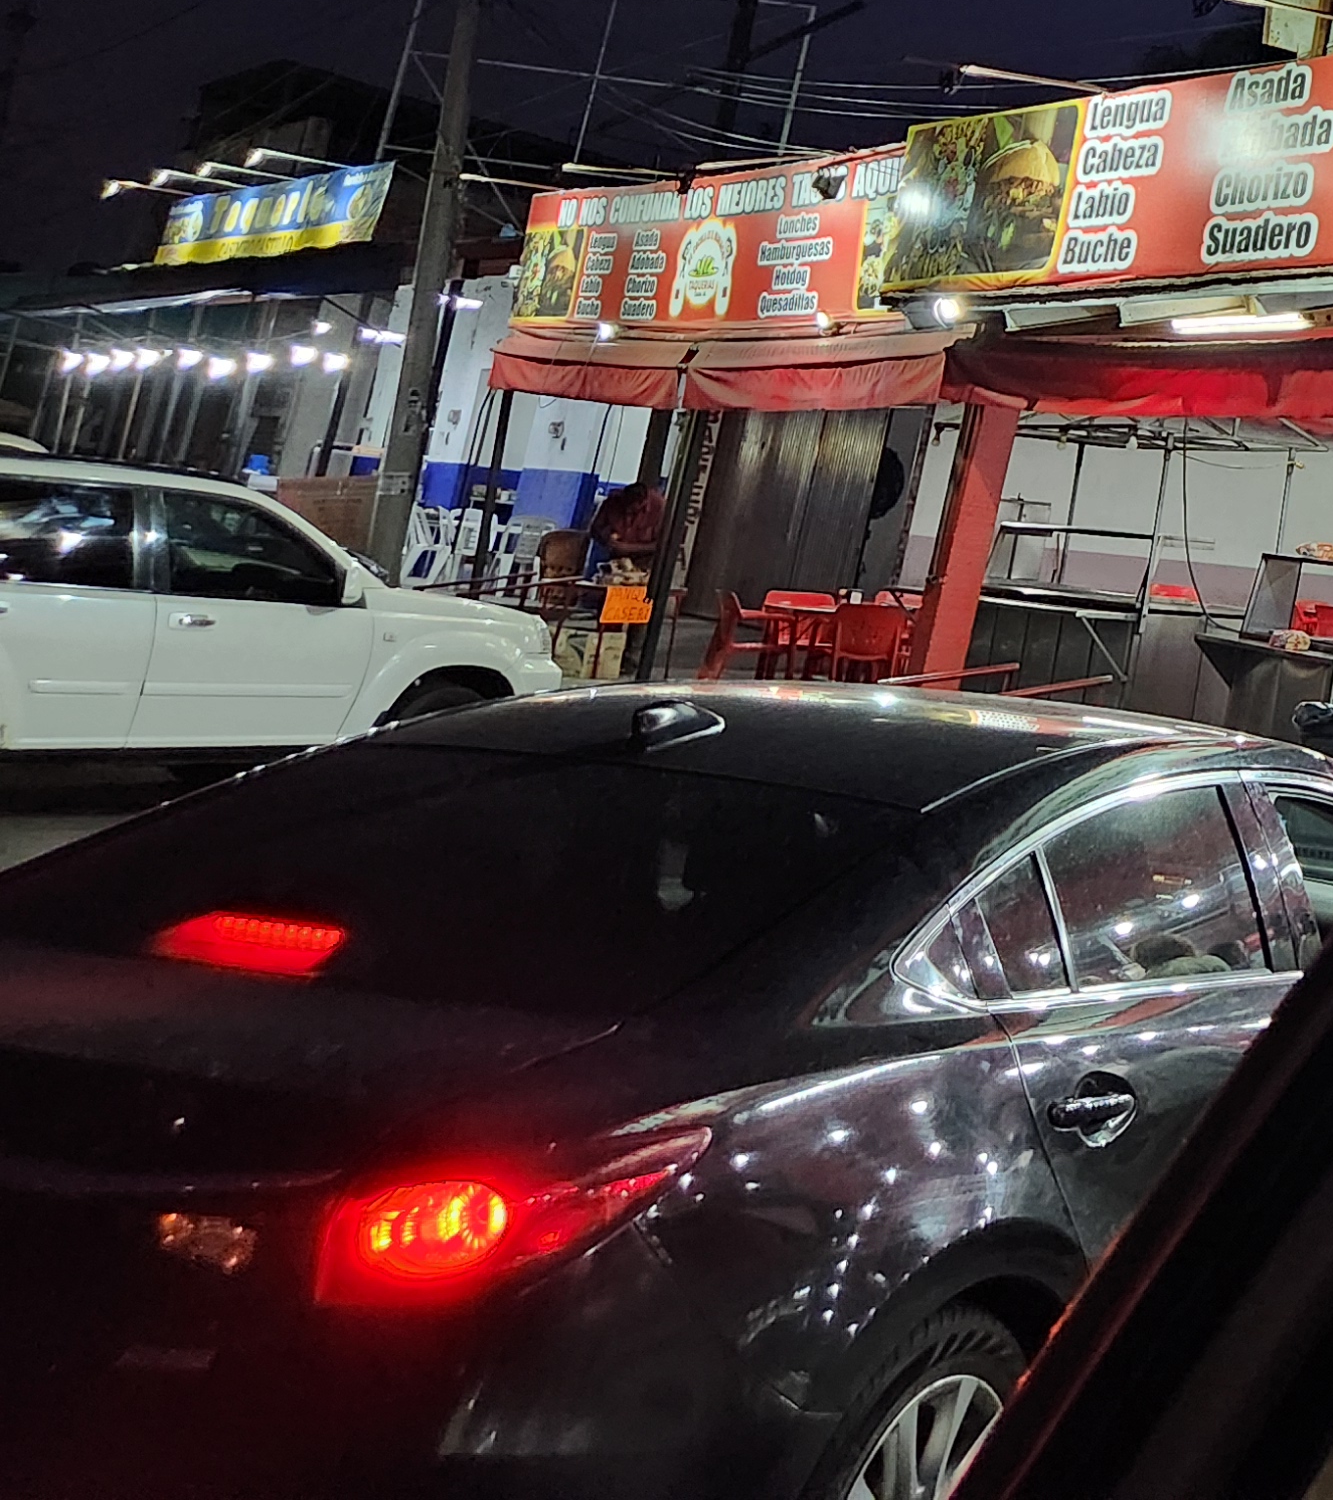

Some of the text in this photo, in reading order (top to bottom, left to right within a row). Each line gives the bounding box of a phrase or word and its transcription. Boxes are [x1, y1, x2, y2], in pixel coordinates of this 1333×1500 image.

[1229, 69, 1307, 110] Asada
[1089, 96, 1166, 132] Lengua
[1083, 143, 1159, 176] Cabeza
[557, 199, 579, 227] NO
[579, 196, 607, 226] NOS
[684, 185, 714, 220] LOS
[716, 176, 786, 216] MEJORES
[1072, 187, 1130, 222] Labio
[1214, 166, 1308, 208] Chorizo
[778, 215, 818, 235] Lonches
[1205, 218, 1313, 257] Suadero
[759, 240, 831, 263] Hamburguesas
[1062, 234, 1132, 268] Buche
